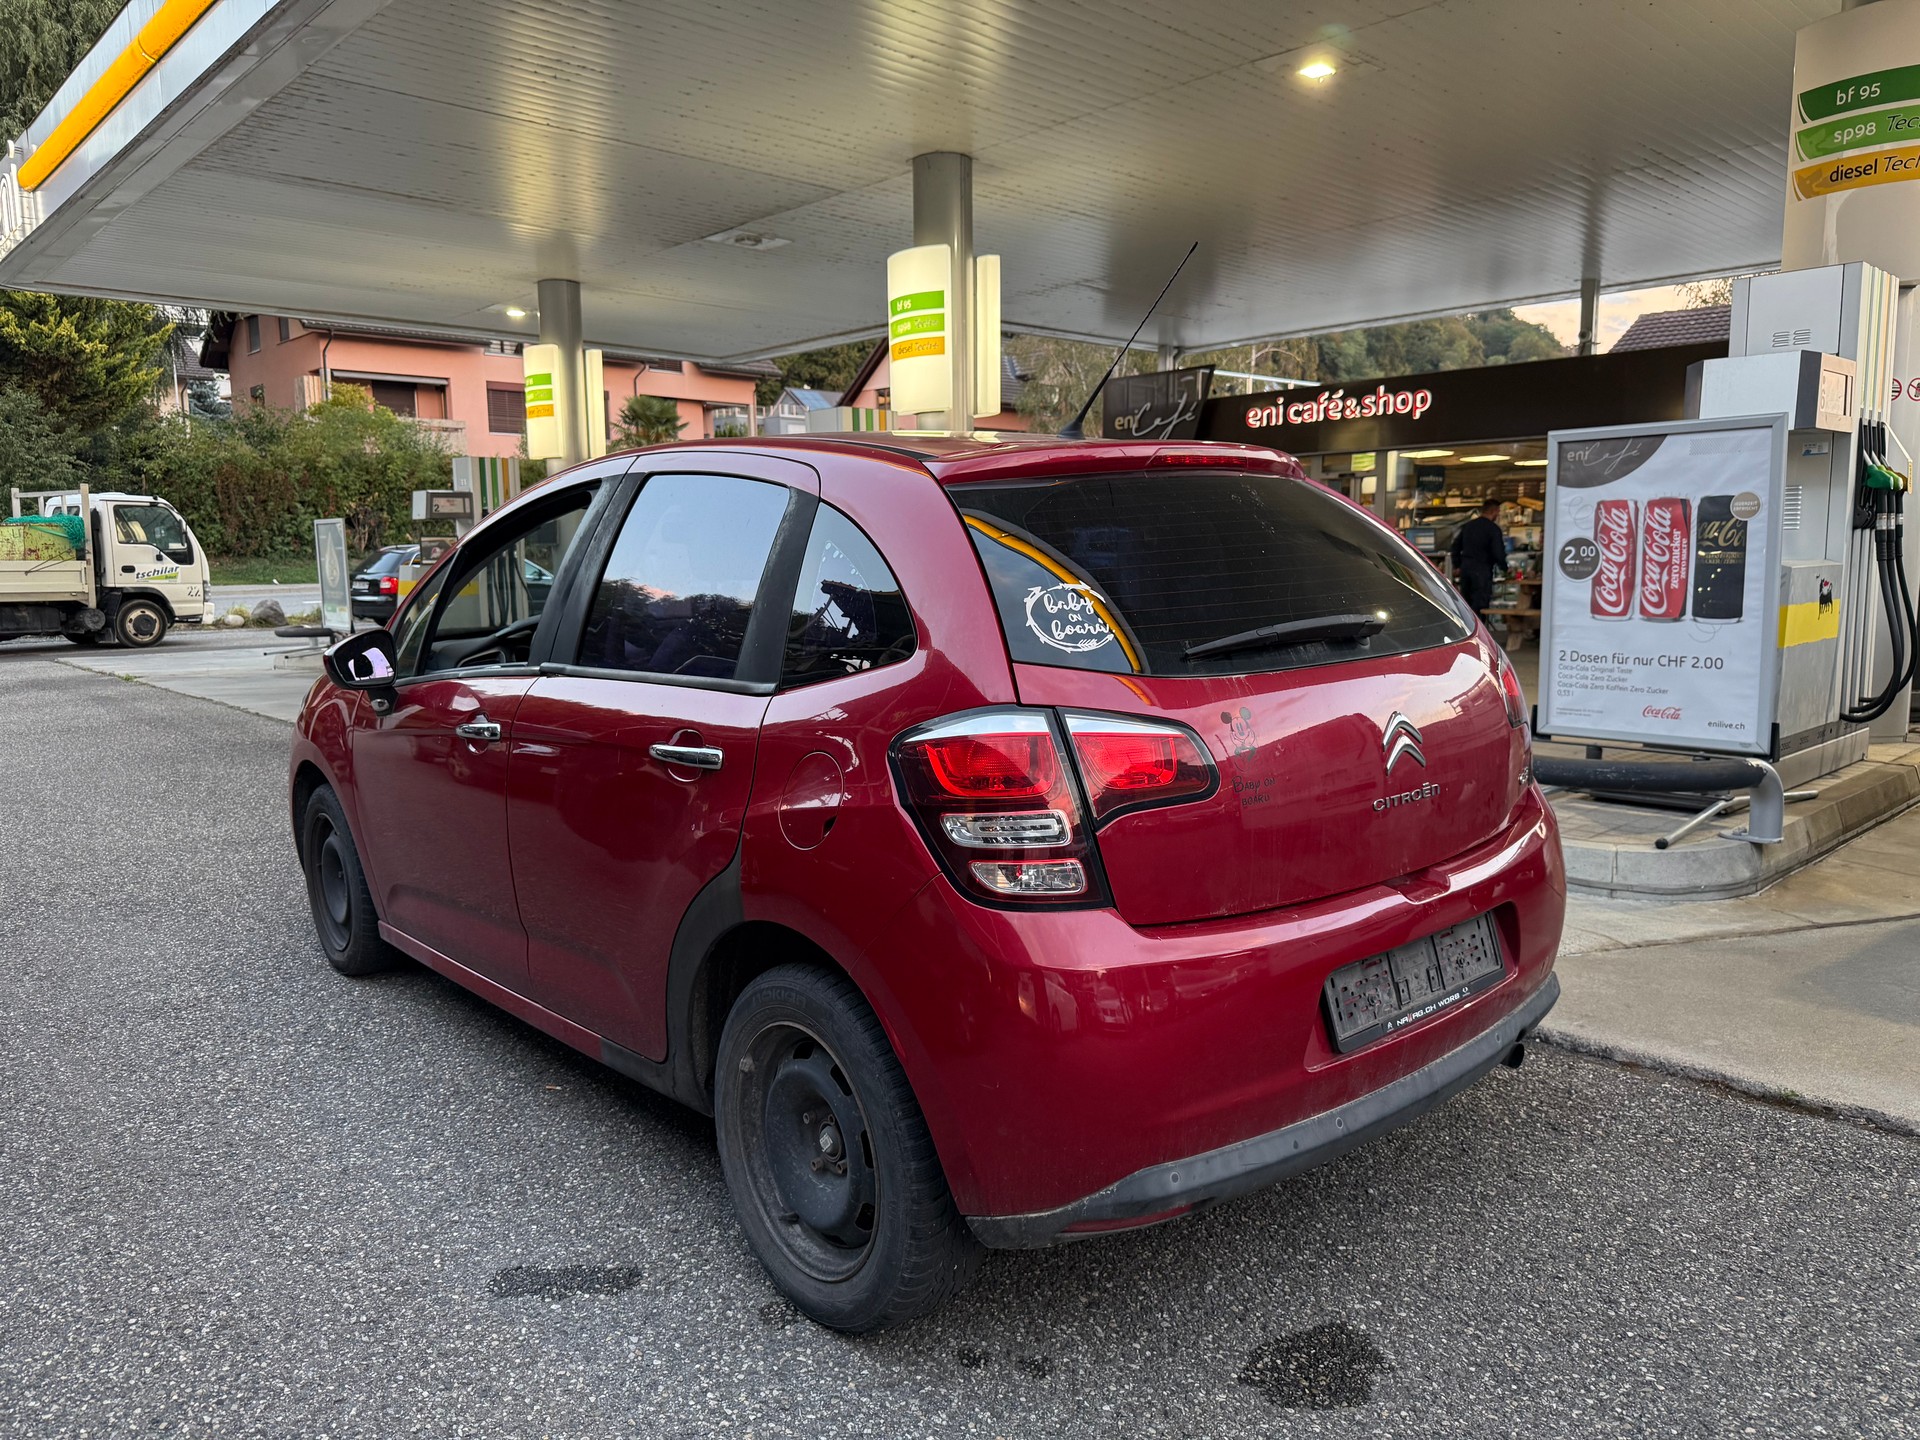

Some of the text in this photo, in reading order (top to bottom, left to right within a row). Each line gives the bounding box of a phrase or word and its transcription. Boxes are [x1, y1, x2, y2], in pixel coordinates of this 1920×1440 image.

[1836, 82, 1881, 105] bf 95
[1833, 114, 1920, 145] sp98 Tec
[1829, 158, 1878, 183] diesel
[1246, 396, 1284, 428] eni
[1669, 528, 1682, 565] zucker
[136, 566, 179, 579] tschilar
[1043, 592, 1095, 615] baby
[1558, 663, 1589, 672] Coca-Cola
[1590, 665, 1615, 675] Original
[1559, 650, 1724, 670] 2 Dosen für nur CHF 2.00
[1557, 672, 1628, 683] Coca-Cola Zero Zucker
[1557, 680, 1669, 694] Coca-Cola Zero Koffein Zero Zucker
[1707, 720, 1746, 730] enilive.ch
[1437, 993, 1460, 1007] WORB
